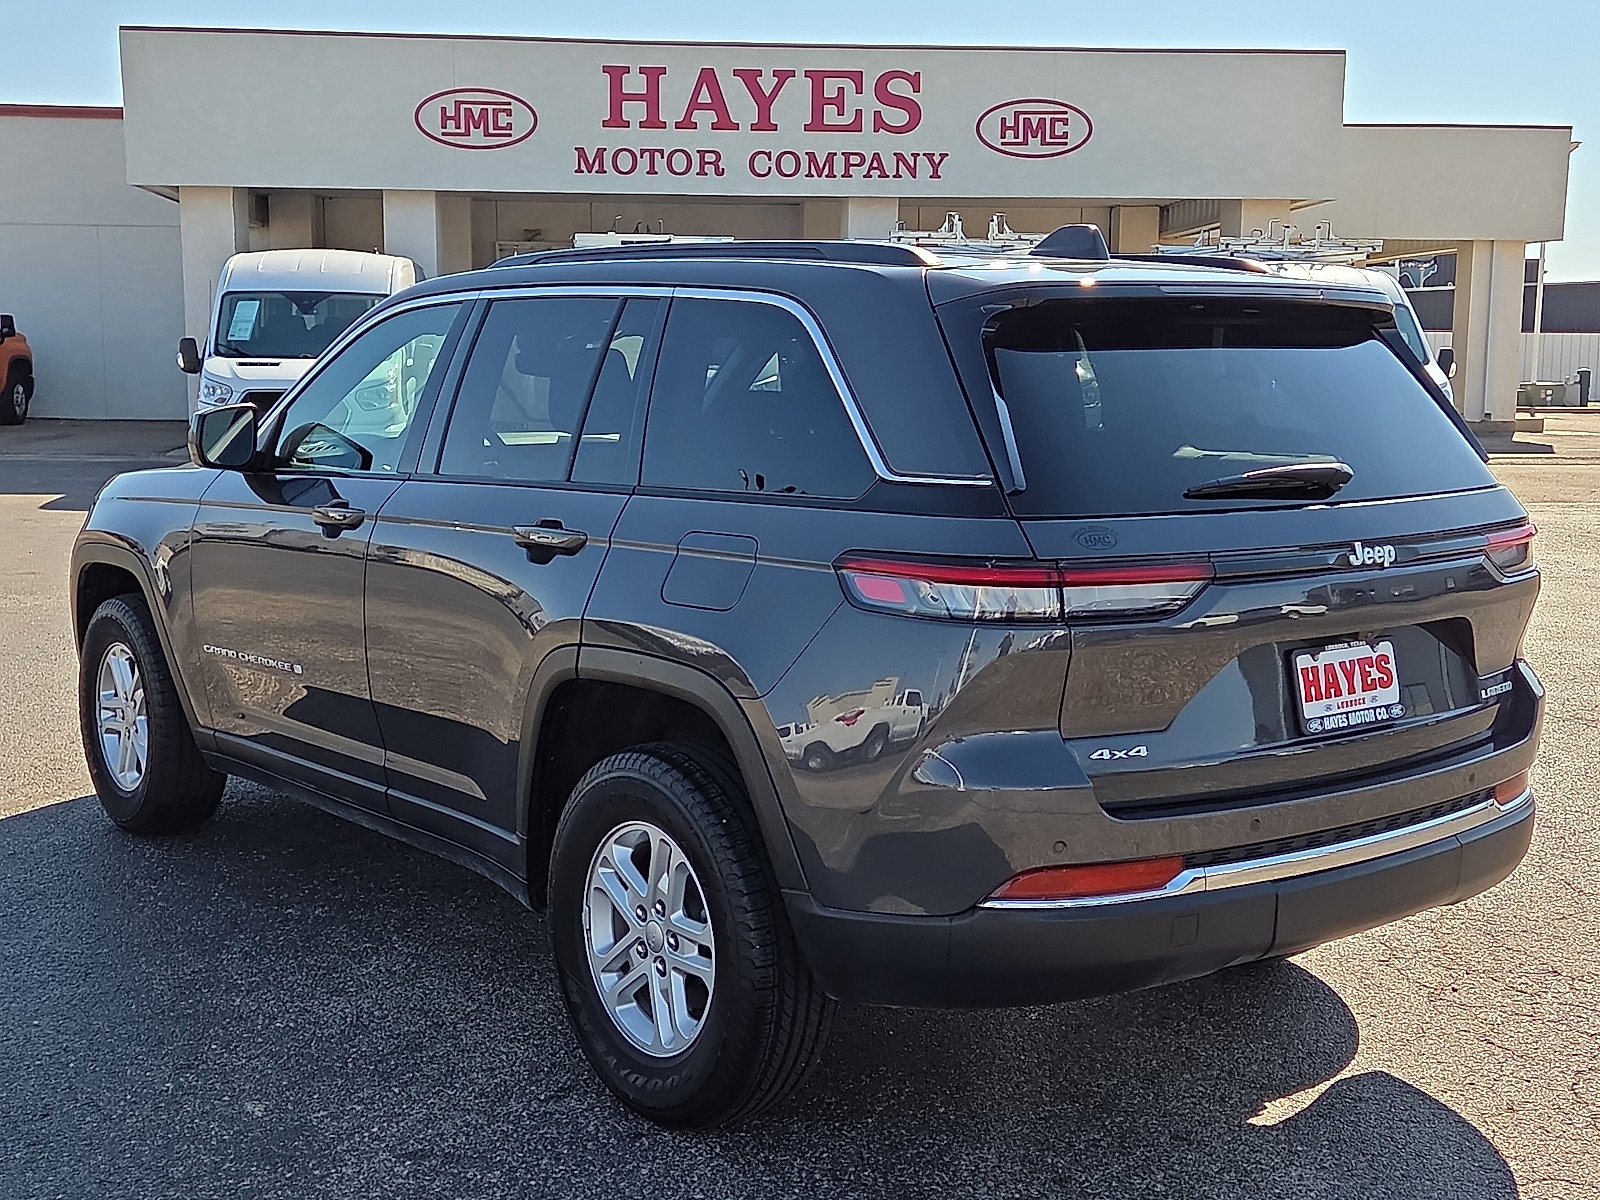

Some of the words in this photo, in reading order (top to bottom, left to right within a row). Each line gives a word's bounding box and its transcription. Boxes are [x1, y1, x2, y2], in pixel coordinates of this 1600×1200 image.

[601, 64, 922, 135] HAYES
[440, 99, 513, 138] HMC
[1000, 110, 1069, 146] HMC
[573, 146, 725, 177] MOTOR
[749, 150, 949, 179] COMPANY
[1348, 541, 1396, 567] Jeep
[203, 644, 237, 659] GRAND
[238, 652, 293, 672] CHEROKEE
[1300, 653, 1393, 703] HAYES
[1323, 713, 1348, 729] HAYES
[1348, 709, 1375, 726] MOTOR
[1375, 706, 1389, 720] CO.
[1089, 745, 1149, 760] 4x4
